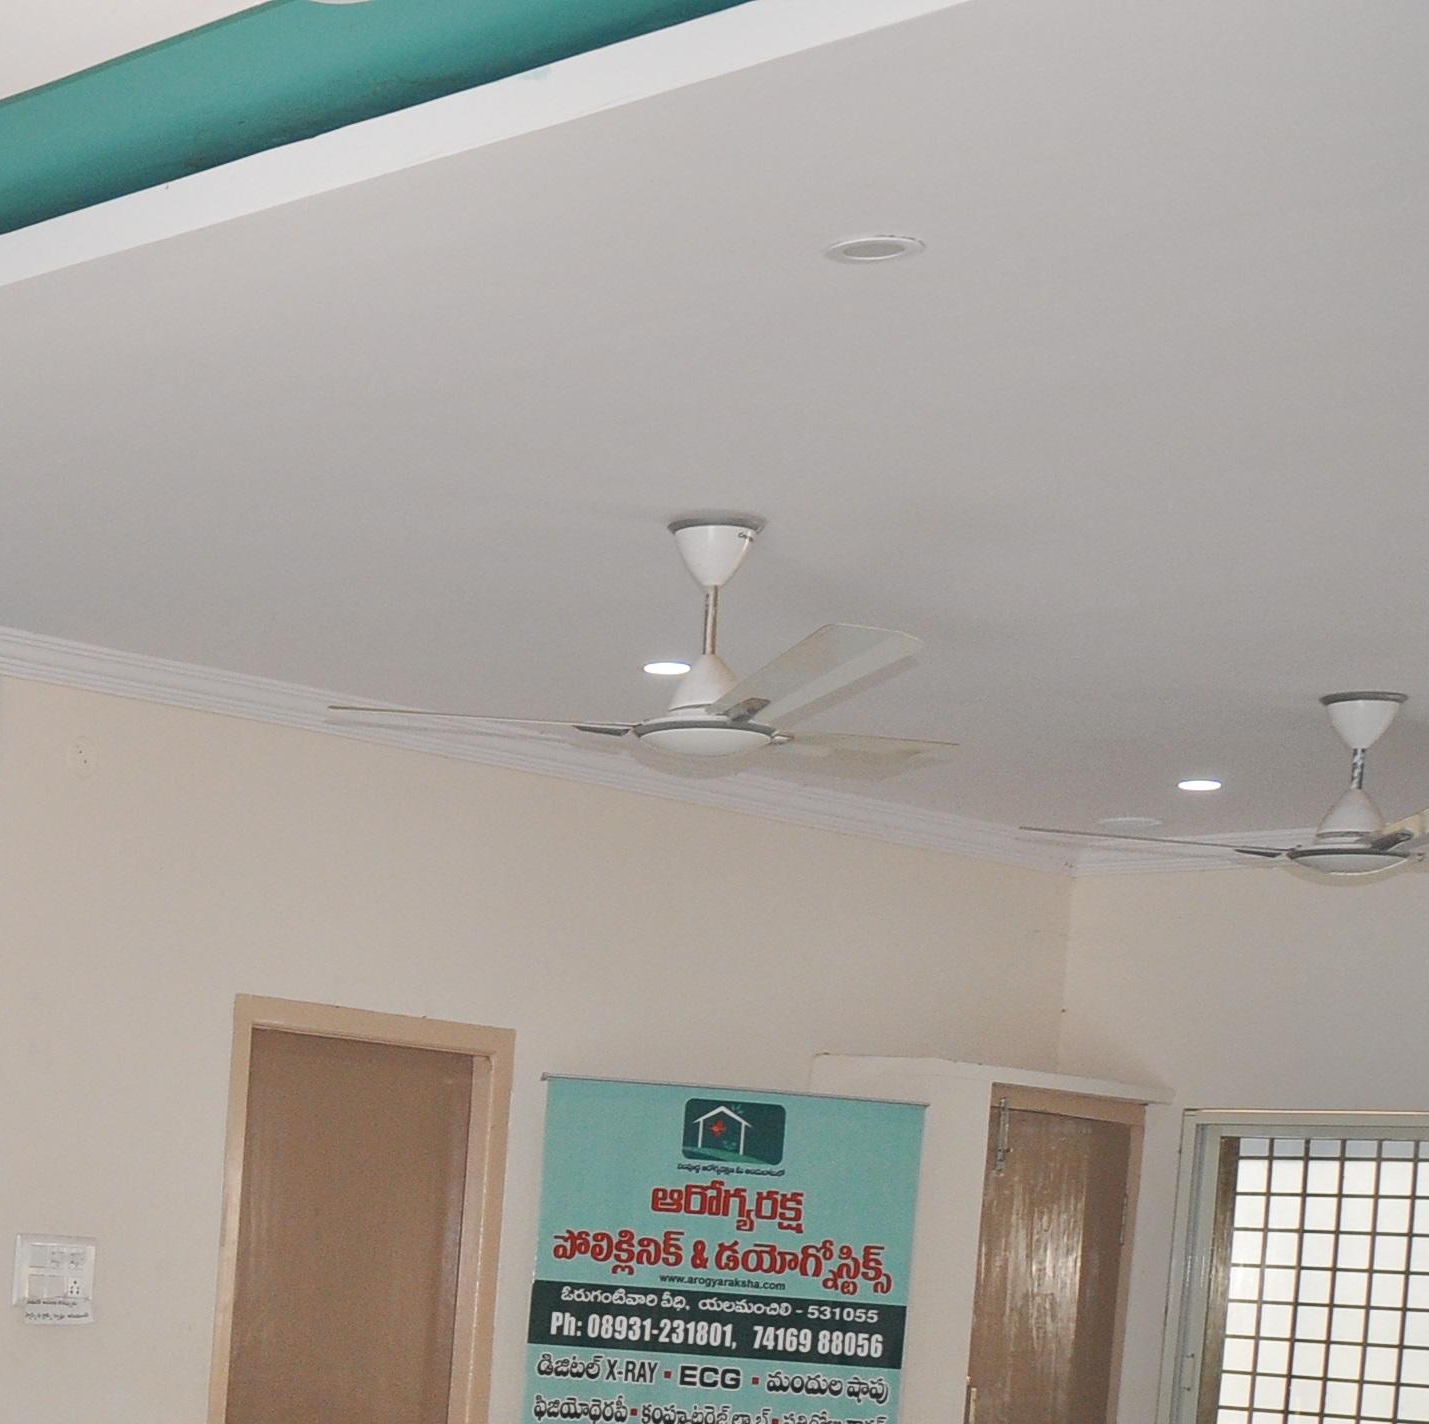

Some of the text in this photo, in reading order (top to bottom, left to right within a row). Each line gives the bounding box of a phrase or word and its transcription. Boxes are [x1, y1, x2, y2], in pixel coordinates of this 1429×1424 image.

[651, 1180, 805, 1233] ఆరోగ్యరక్ష
[691, 1240, 709, 1269] &
[659, 1273, 786, 1291] www.arogyaraksha.com
[807, 1306, 879, 1323] 531055
[550, 1311, 884, 1358] Ph: 08931-231801, 74169 88056
[606, 1358, 659, 1384] X-RAY
[679, 1365, 741, 1389] ECG
